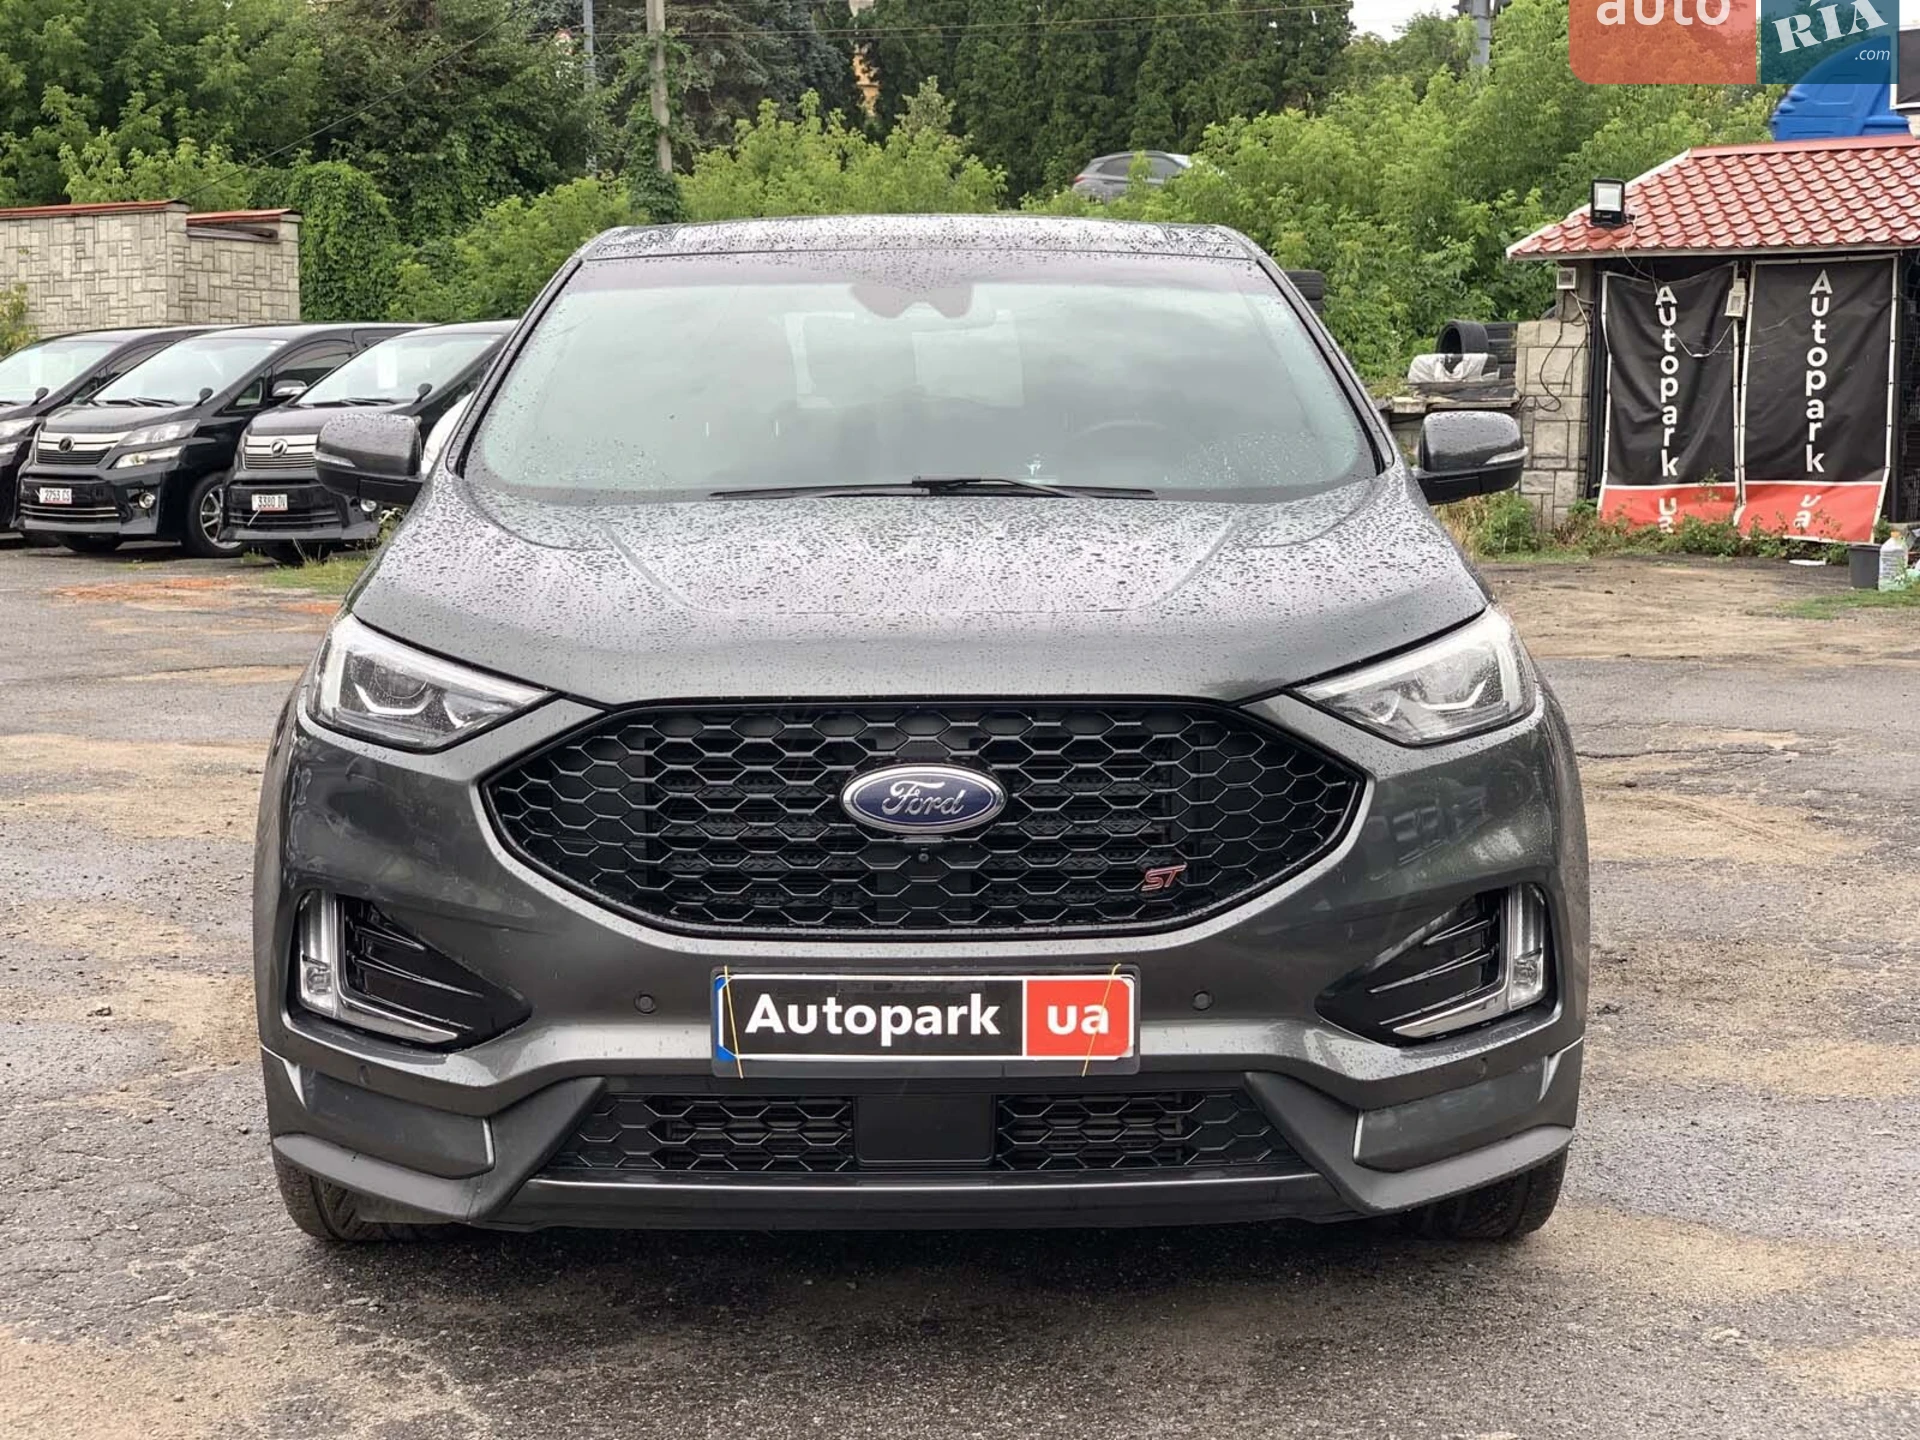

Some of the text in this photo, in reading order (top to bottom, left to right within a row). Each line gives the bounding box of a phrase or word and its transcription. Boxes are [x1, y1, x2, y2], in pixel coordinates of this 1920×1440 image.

[1655, 285, 1680, 477] Autopark
[1804, 269, 1833, 473] Autopark
[882, 780, 966, 815] Ford
[1141, 861, 1188, 891] ST
[744, 992, 1110, 1047] Autopark ua
